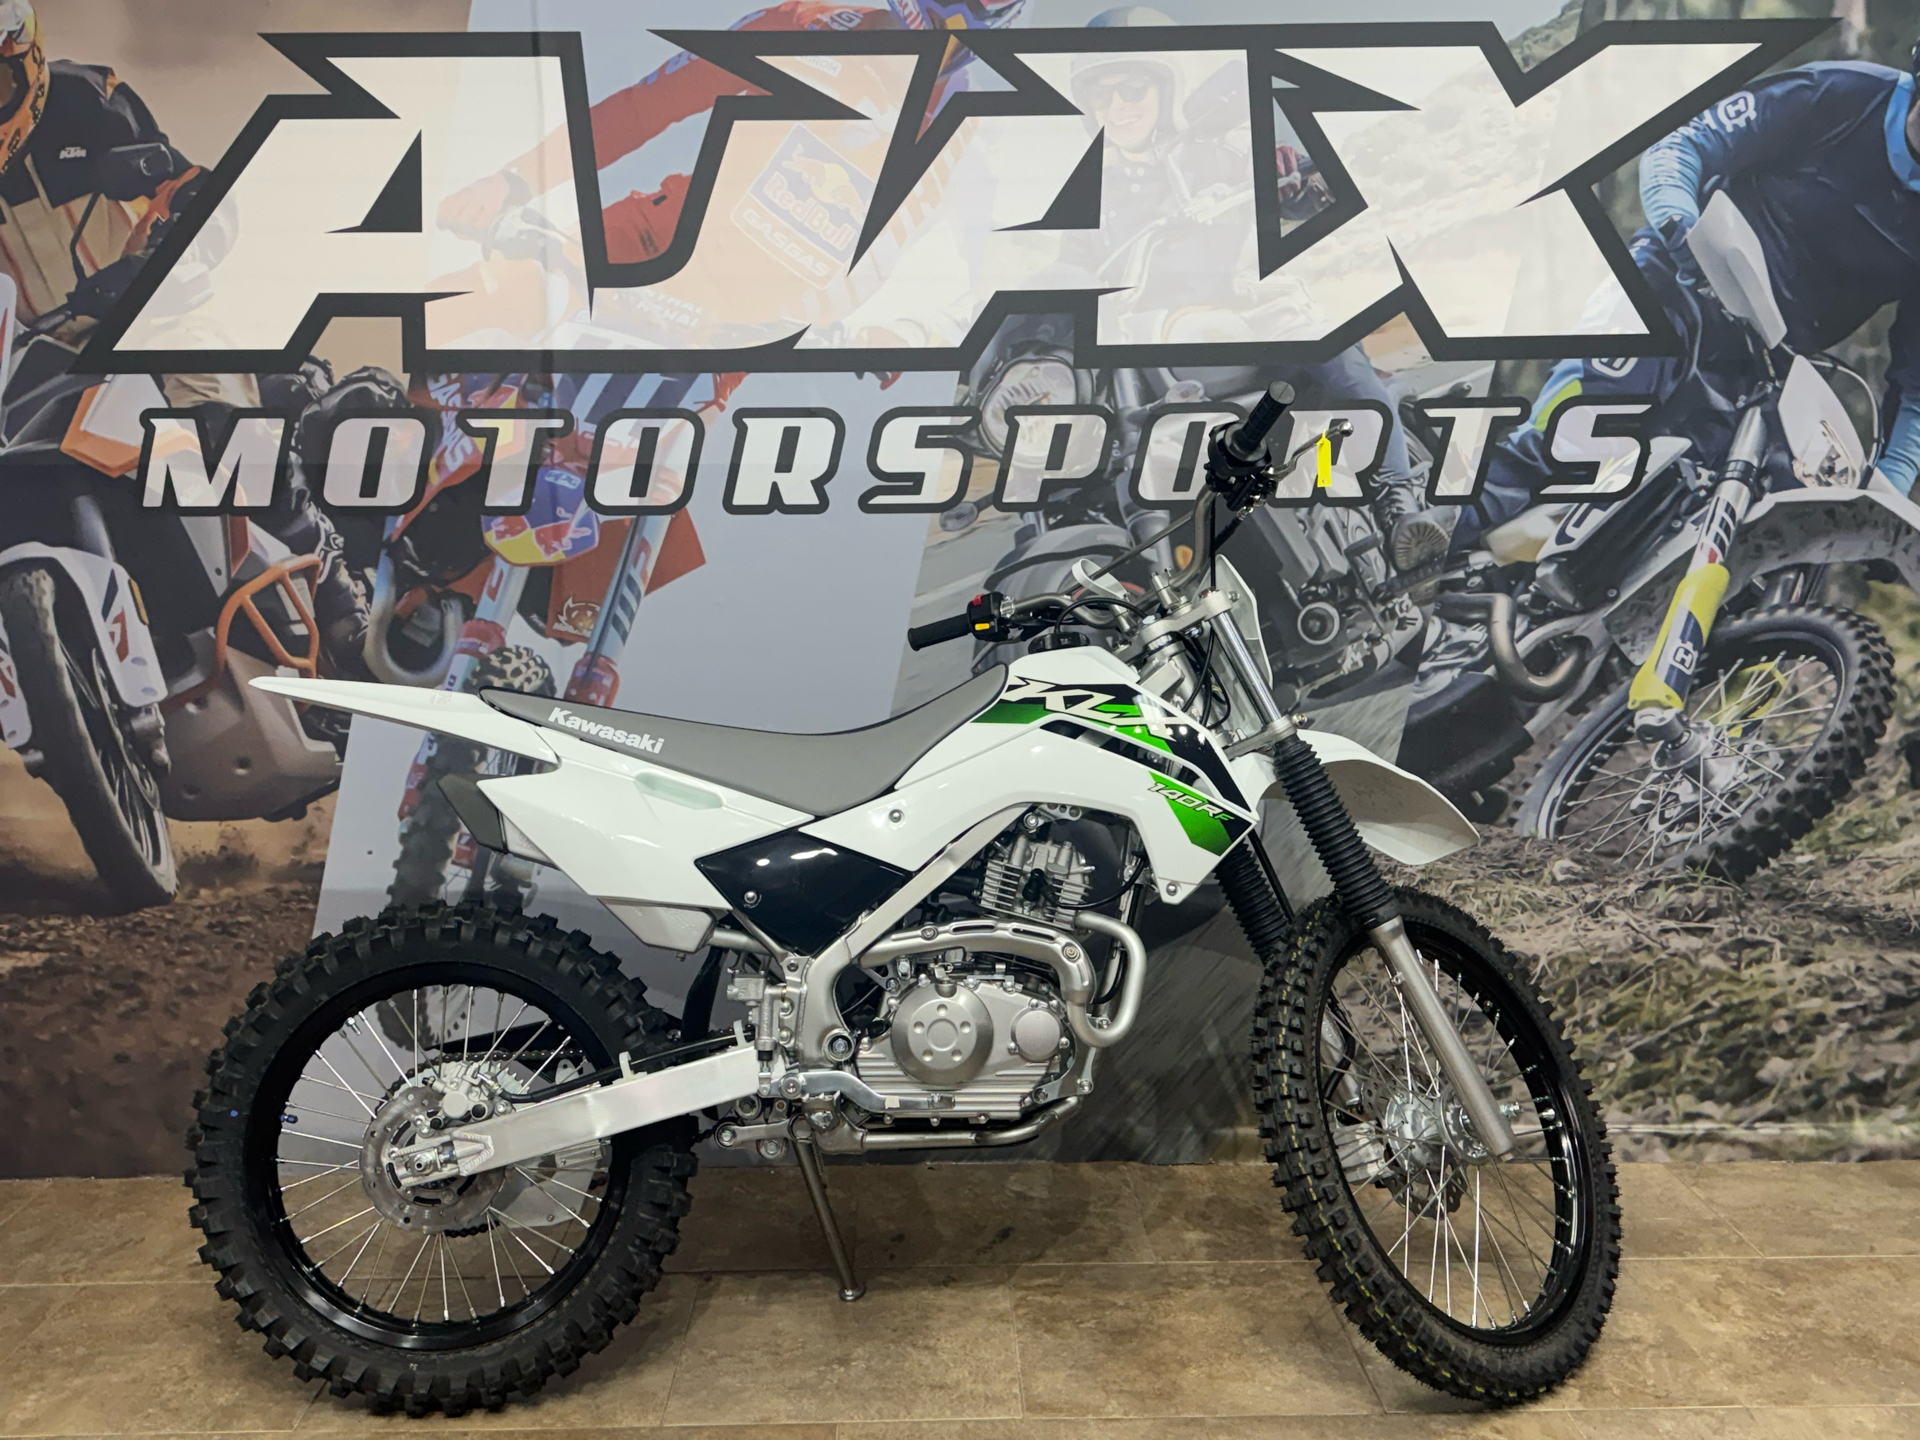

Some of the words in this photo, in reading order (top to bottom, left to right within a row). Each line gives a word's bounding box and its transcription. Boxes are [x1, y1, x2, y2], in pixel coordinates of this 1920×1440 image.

[70, 18, 1840, 373] AJAX
[742, 208, 831, 278] GASGAS
[140, 396, 1660, 515] MOTORSPORTS
[547, 707, 665, 754] Kawasaki
[1001, 676, 1190, 742] KLX
